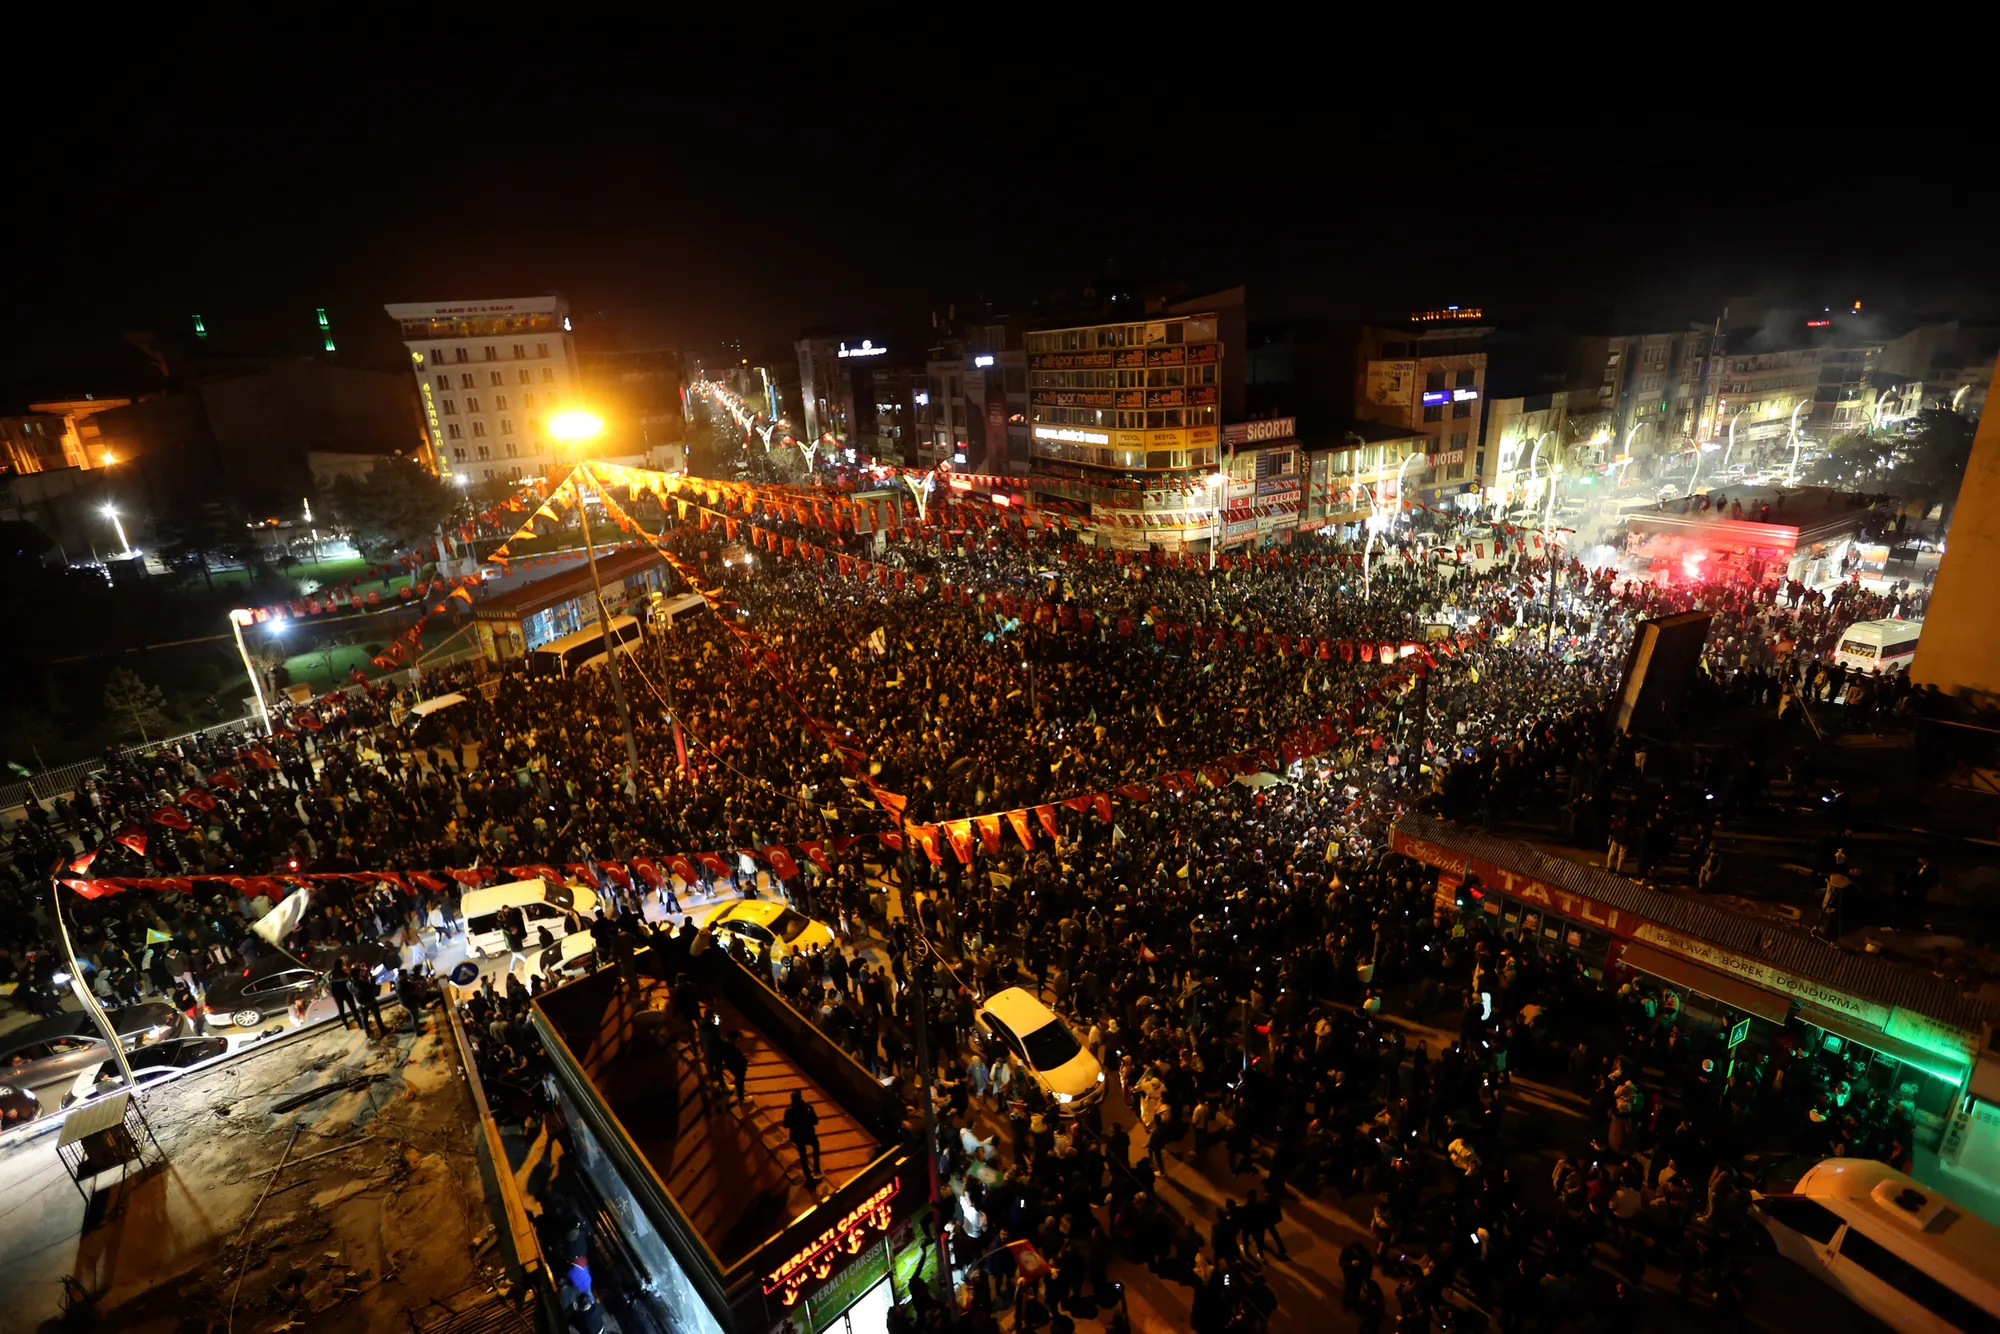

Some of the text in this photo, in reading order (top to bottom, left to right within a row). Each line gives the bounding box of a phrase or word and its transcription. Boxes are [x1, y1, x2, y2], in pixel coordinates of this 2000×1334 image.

[1434, 450, 1463, 466] NOTER
[1266, 491, 1300, 503] FATURA
[1499, 868, 1616, 929] TATLI
[1657, 933, 1860, 1012] BAKLAVA BÖREK DONDURMA
